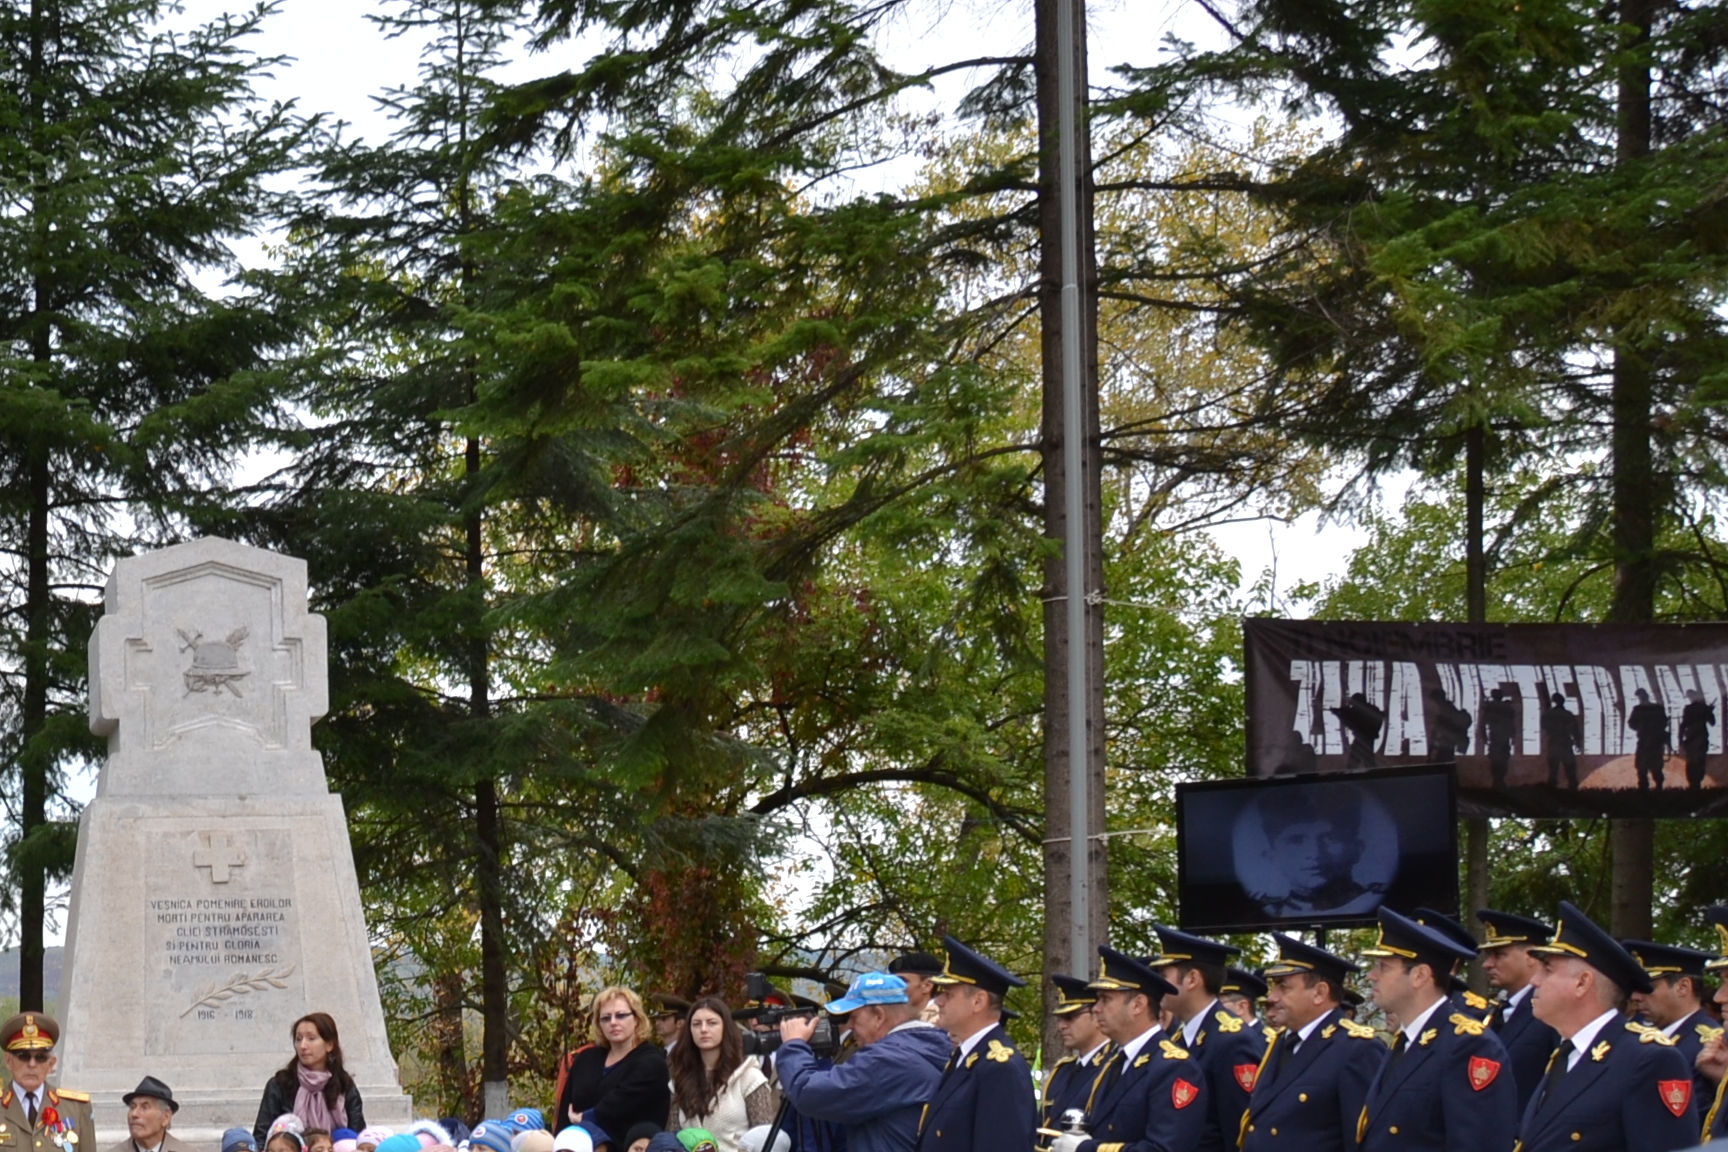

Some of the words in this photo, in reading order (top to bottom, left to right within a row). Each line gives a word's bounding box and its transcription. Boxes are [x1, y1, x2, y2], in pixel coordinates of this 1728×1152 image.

[196, 899, 246, 909] POMENIRE
[250, 898, 292, 909] EROILOR
[190, 913, 231, 923] PENTRU
[179, 941, 218, 951] PENTRU
[224, 940, 261, 950] GLORIA
[169, 953, 220, 965] NEAMULUI
[197, 1010, 215, 1020] 1916
[235, 1010, 253, 1020] 1918
